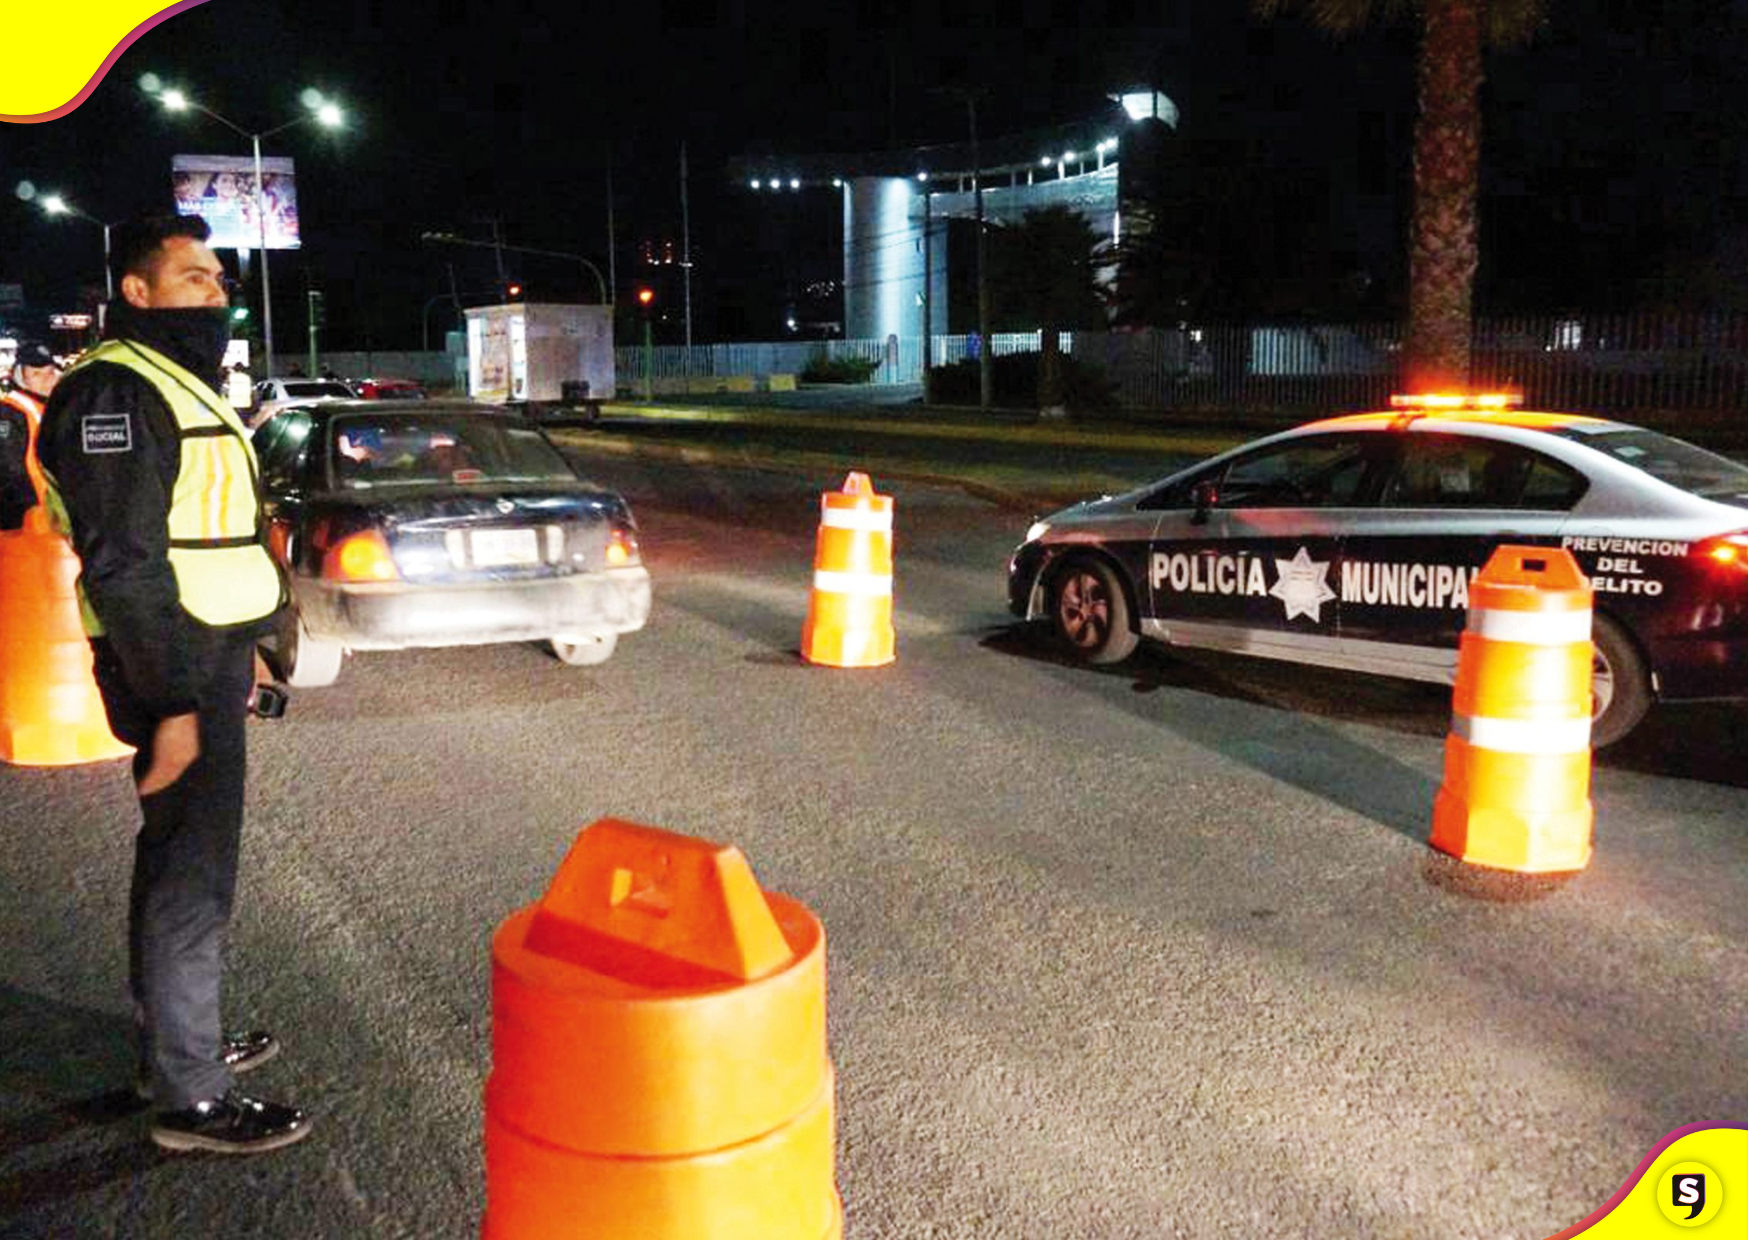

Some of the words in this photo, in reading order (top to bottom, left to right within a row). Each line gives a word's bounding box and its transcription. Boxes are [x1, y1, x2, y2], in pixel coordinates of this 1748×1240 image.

[1562, 536, 1689, 556] PREVENCION
[1596, 557, 1644, 574] DEL
[1590, 576, 1663, 596] ELITO
